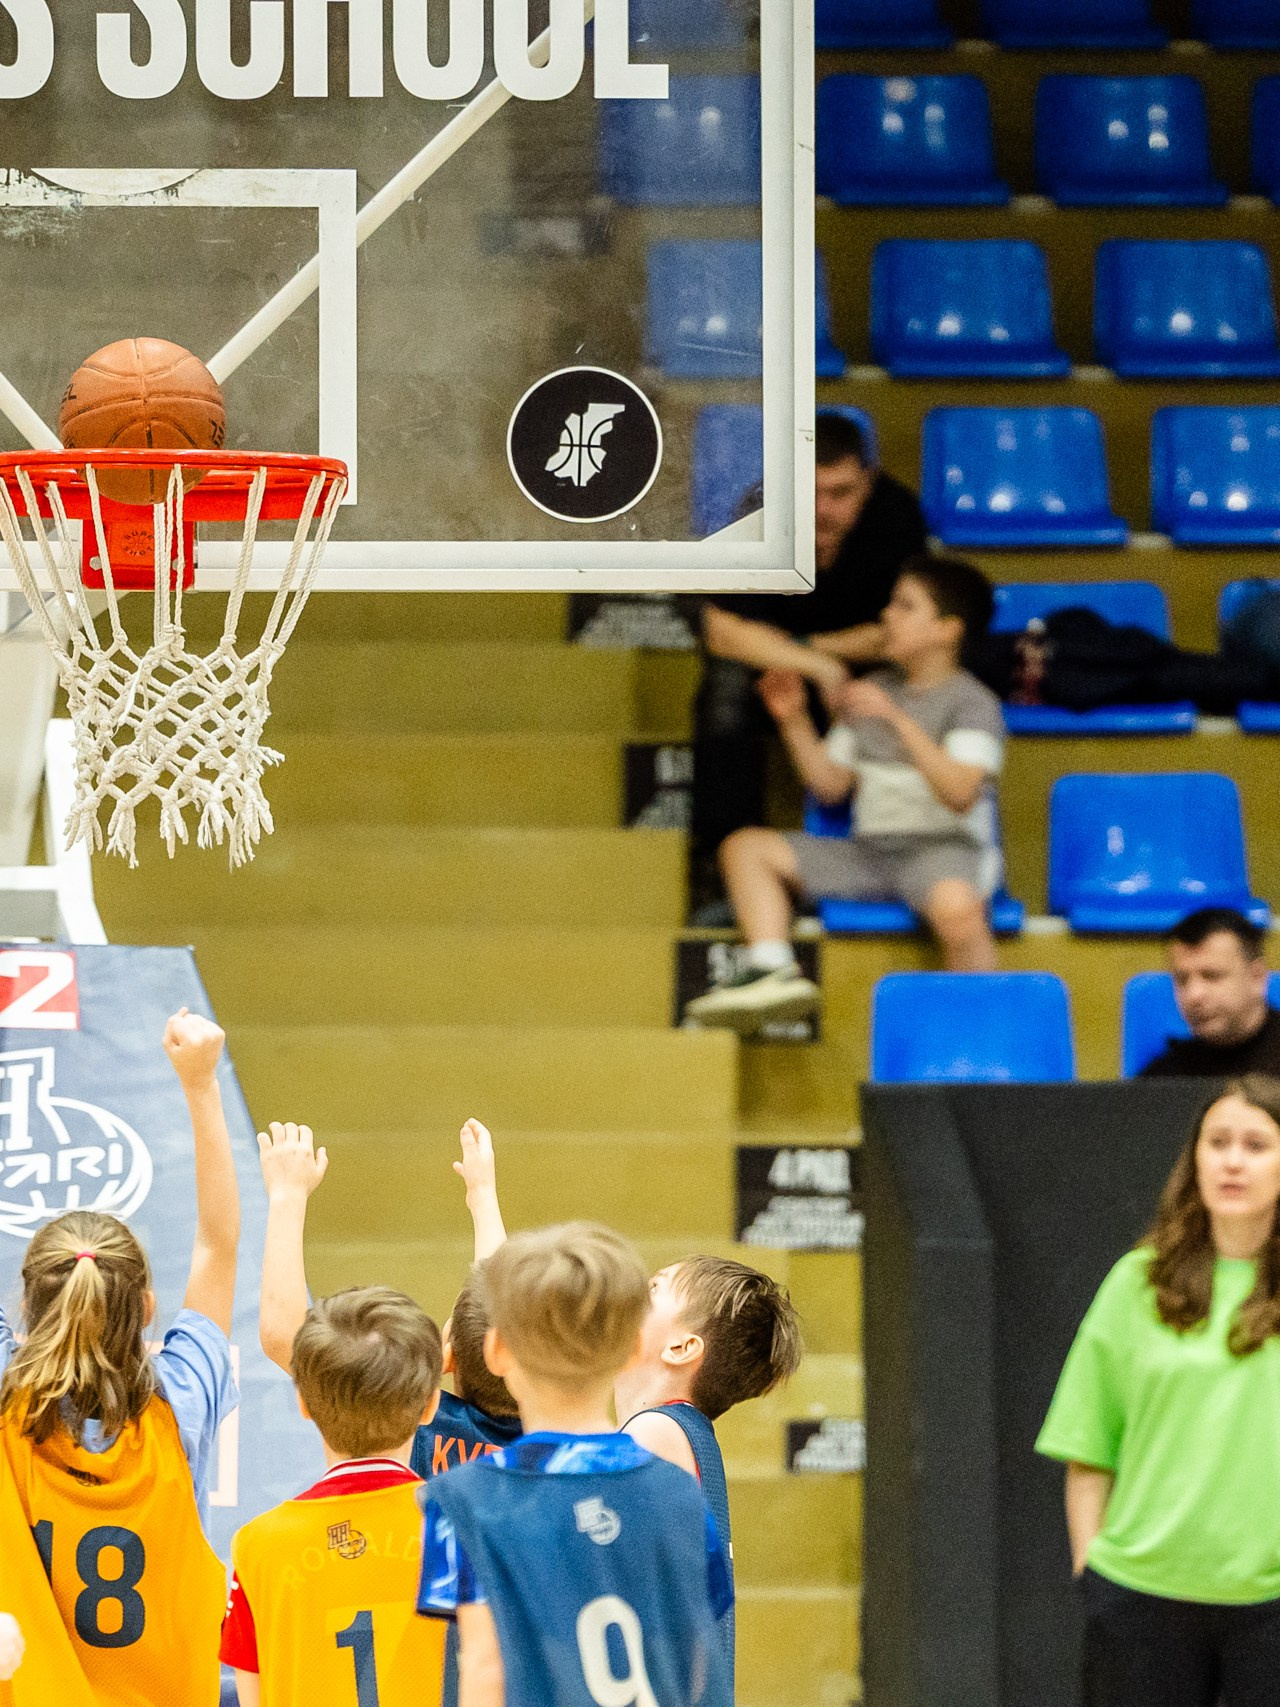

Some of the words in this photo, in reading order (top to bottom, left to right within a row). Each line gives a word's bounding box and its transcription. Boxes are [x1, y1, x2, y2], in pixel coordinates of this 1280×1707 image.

[96, 0, 669, 100] SCHOOL
[335, 1610, 380, 1707] 1
[576, 1595, 660, 1707] 9
